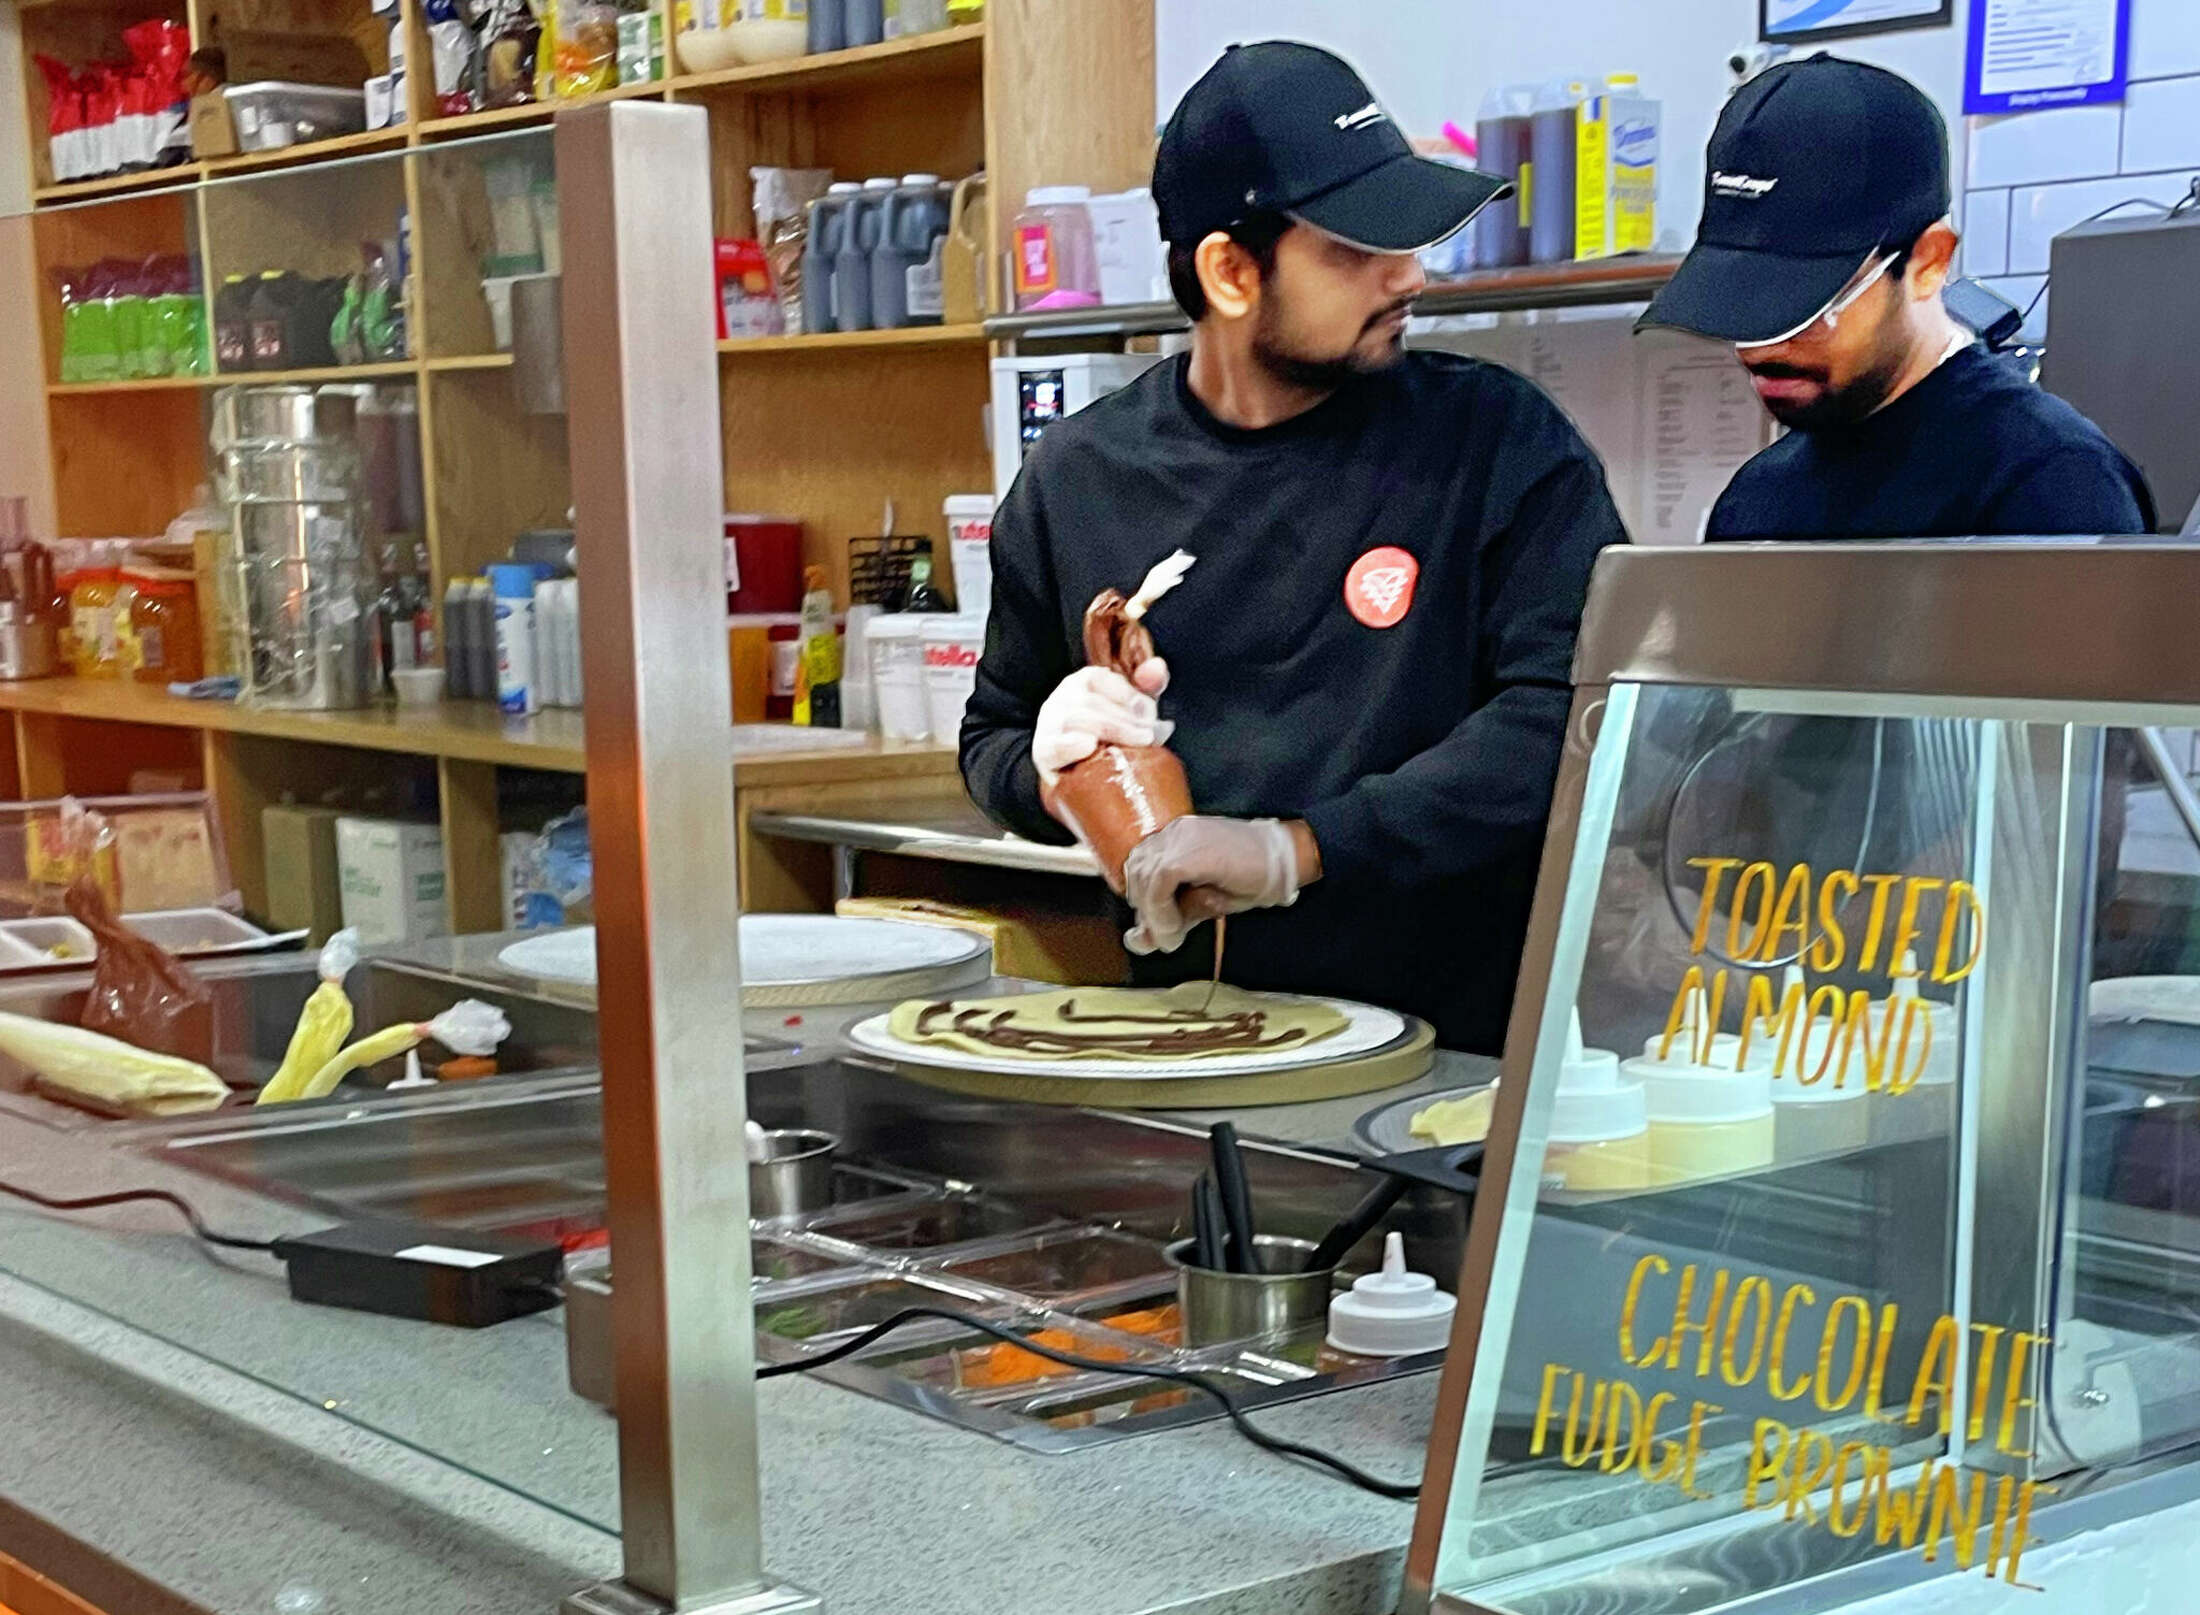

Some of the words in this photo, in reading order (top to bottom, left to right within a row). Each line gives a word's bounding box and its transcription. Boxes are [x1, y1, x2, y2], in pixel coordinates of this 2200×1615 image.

[1685, 857, 1983, 984] TOASTED
[1657, 966, 1934, 1096] ALMOND
[1619, 1254, 2052, 1458] CHOCOLATE
[1530, 1362, 1723, 1500] FUDGE
[1742, 1417, 2061, 1592] BROWNIE
